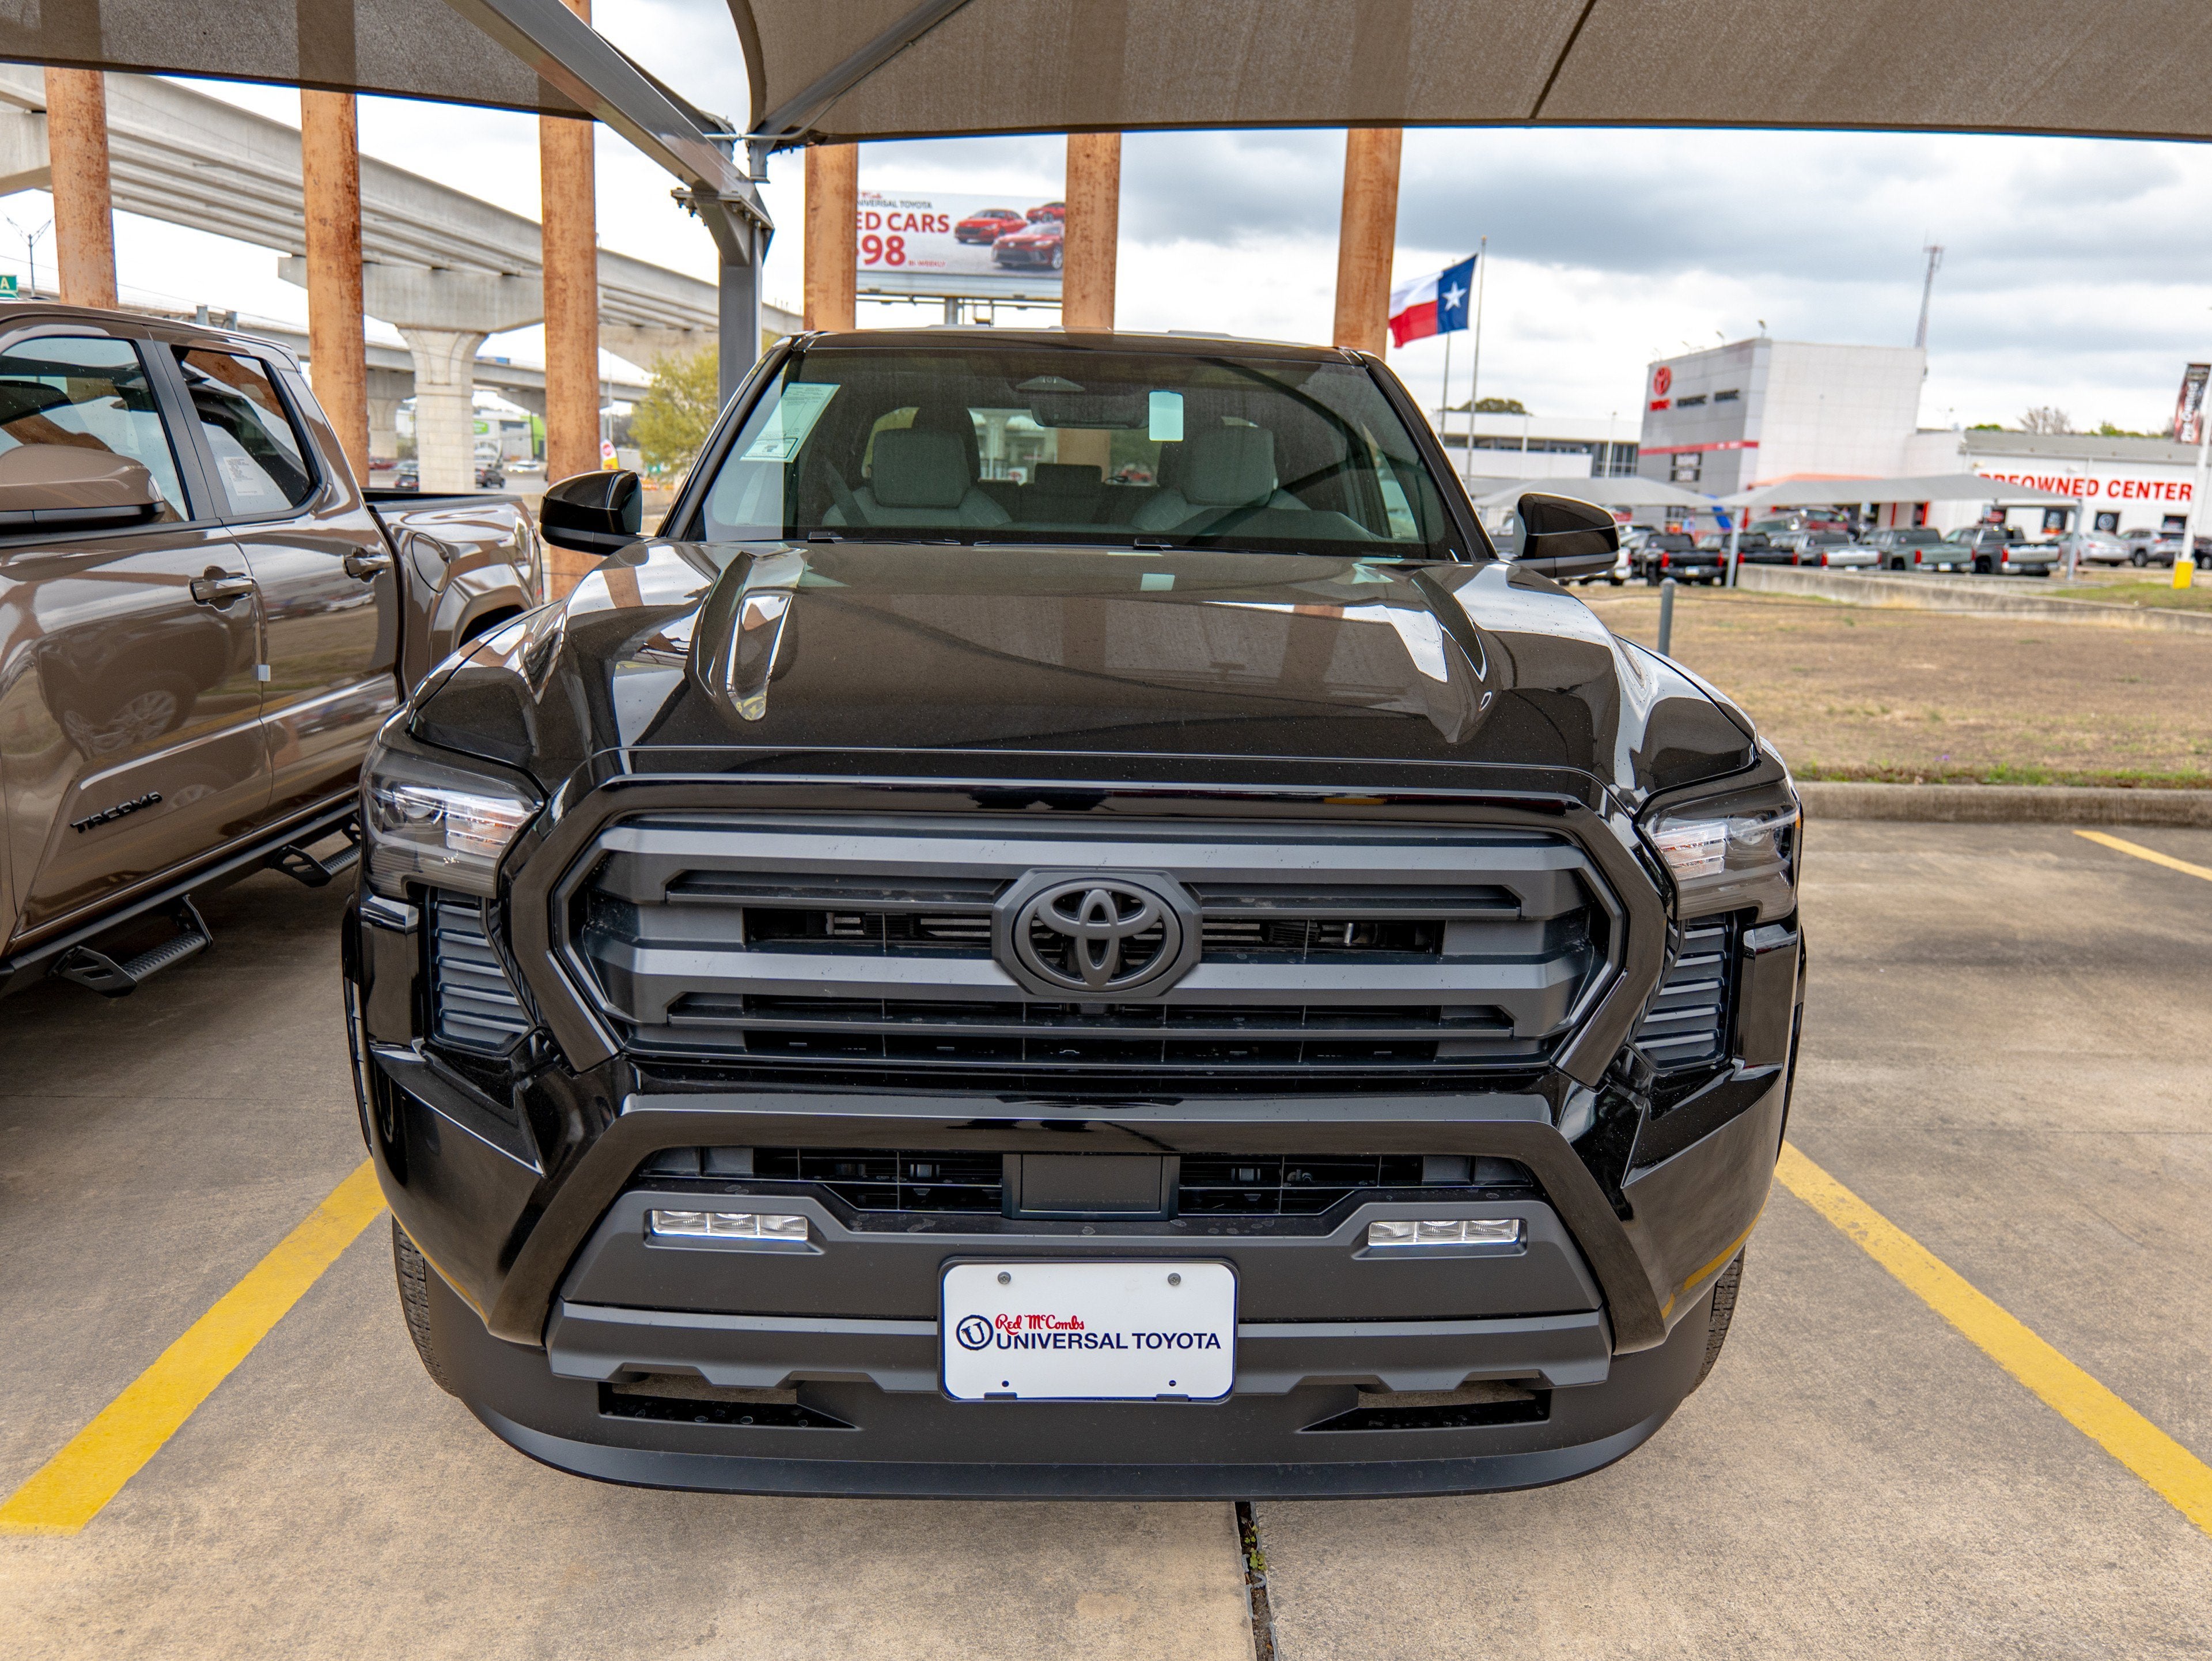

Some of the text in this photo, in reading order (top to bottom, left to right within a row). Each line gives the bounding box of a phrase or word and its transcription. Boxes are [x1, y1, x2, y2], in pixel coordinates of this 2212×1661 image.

[887, 212, 950, 233] CARS
[857, 234, 906, 266] 98
[1979, 473, 2192, 501] OWNED CENTER
[70, 791, 162, 833] TACOMA
[995, 1314, 1085, 1335] Red McCombs
[996, 1332, 1222, 1350] UNIVERSAL TOYOTA
